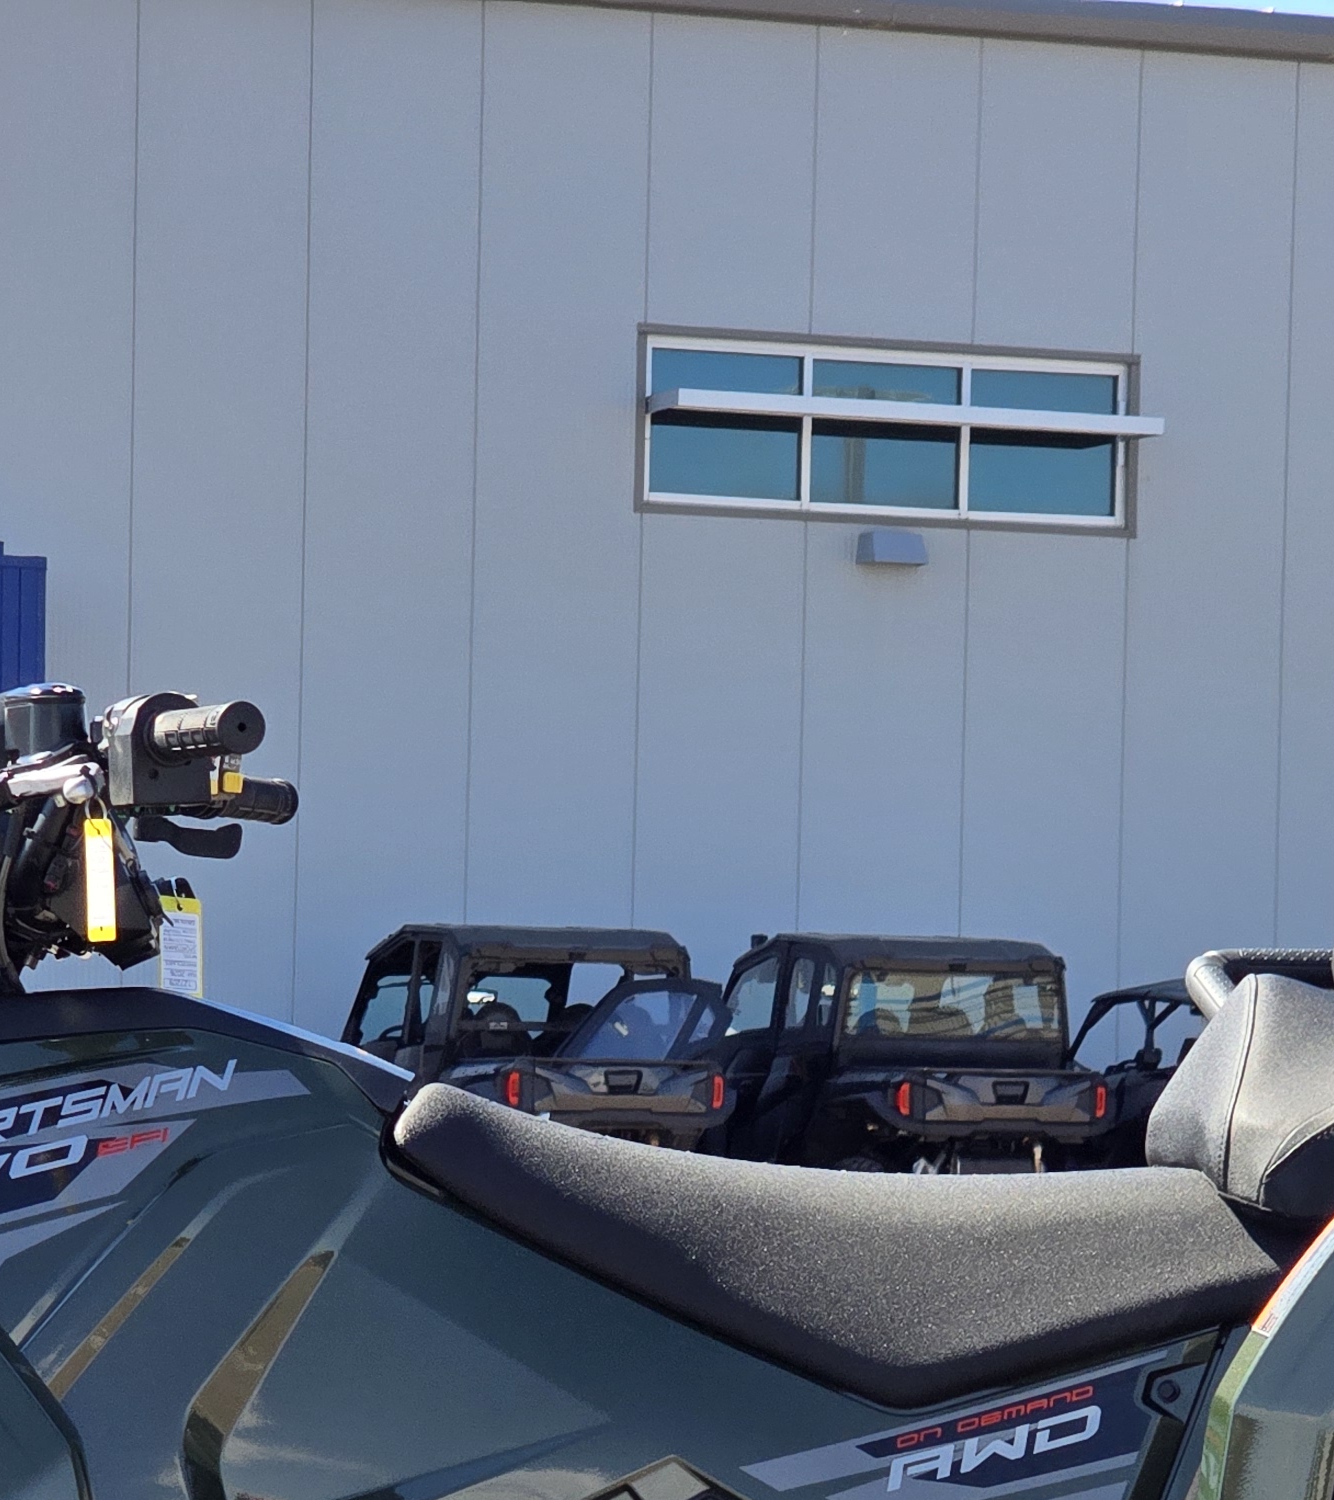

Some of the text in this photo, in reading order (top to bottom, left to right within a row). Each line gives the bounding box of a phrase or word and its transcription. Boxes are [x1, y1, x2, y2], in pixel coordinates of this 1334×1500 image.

[97, 1127, 169, 1159] EFI
[887, 1404, 1102, 1492] AWD
[896, 1385, 1094, 1450] ON DEMAND
